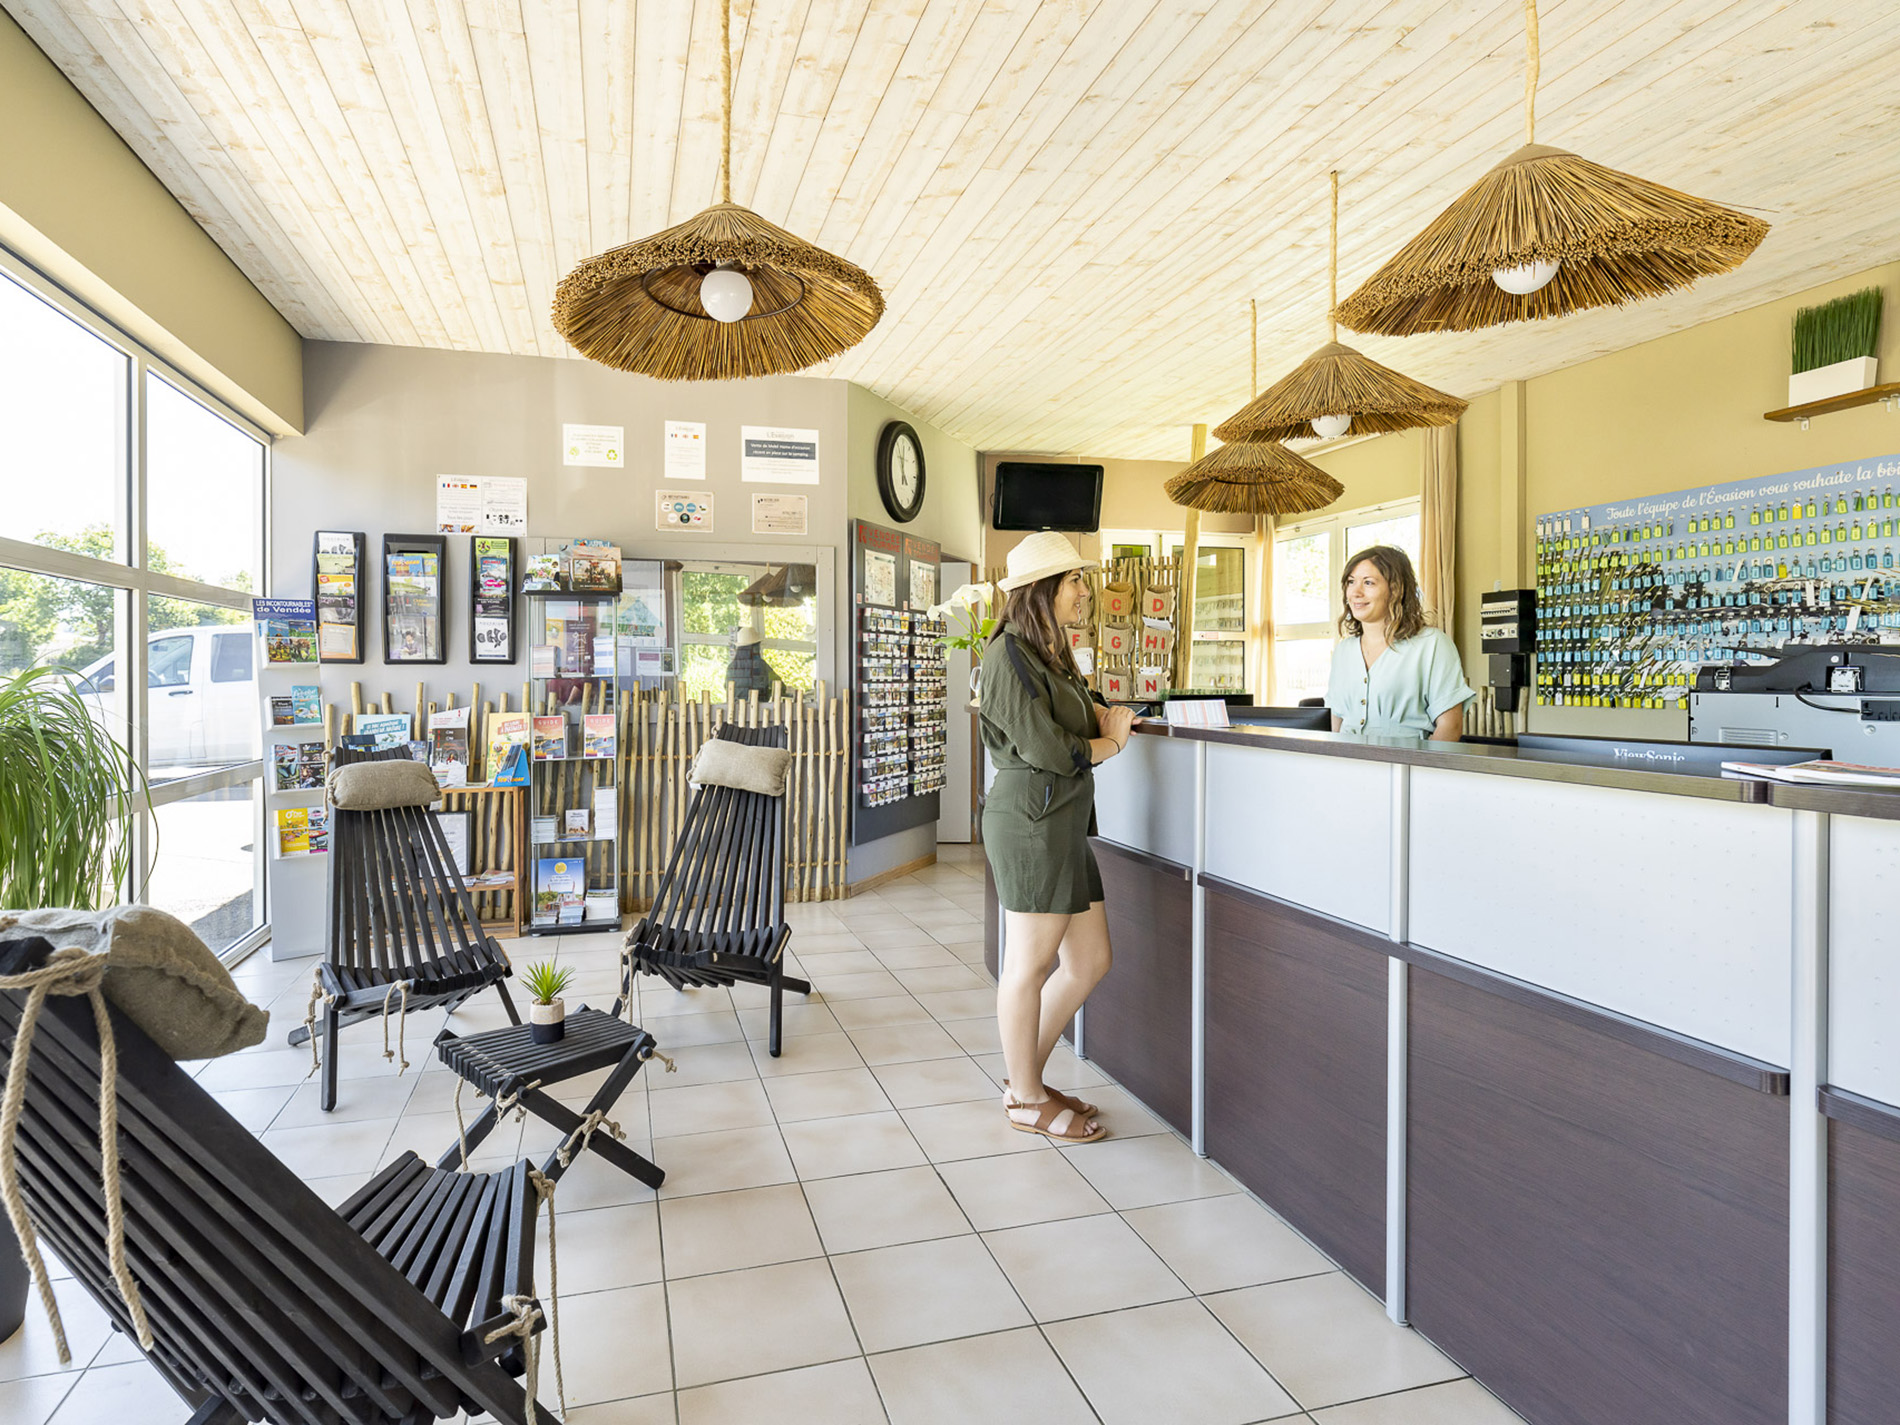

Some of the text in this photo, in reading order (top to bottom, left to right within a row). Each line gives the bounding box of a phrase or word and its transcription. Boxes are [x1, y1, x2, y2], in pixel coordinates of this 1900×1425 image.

[1606, 505, 1636, 520] Toute
[1638, 500, 1680, 519] l'équipe
[1682, 494, 1698, 509] de
[1699, 487, 1757, 506] l'Évasion
[1759, 482, 1790, 497] vous
[1793, 472, 1855, 492] souhaite
[1857, 466, 1875, 481] la
[272, 606, 312, 614] Vendée
[1111, 598, 1164, 612] C D
[1072, 634, 1081, 647] F
[1111, 636, 1122, 649] G
[1109, 679, 1157, 692] M N
